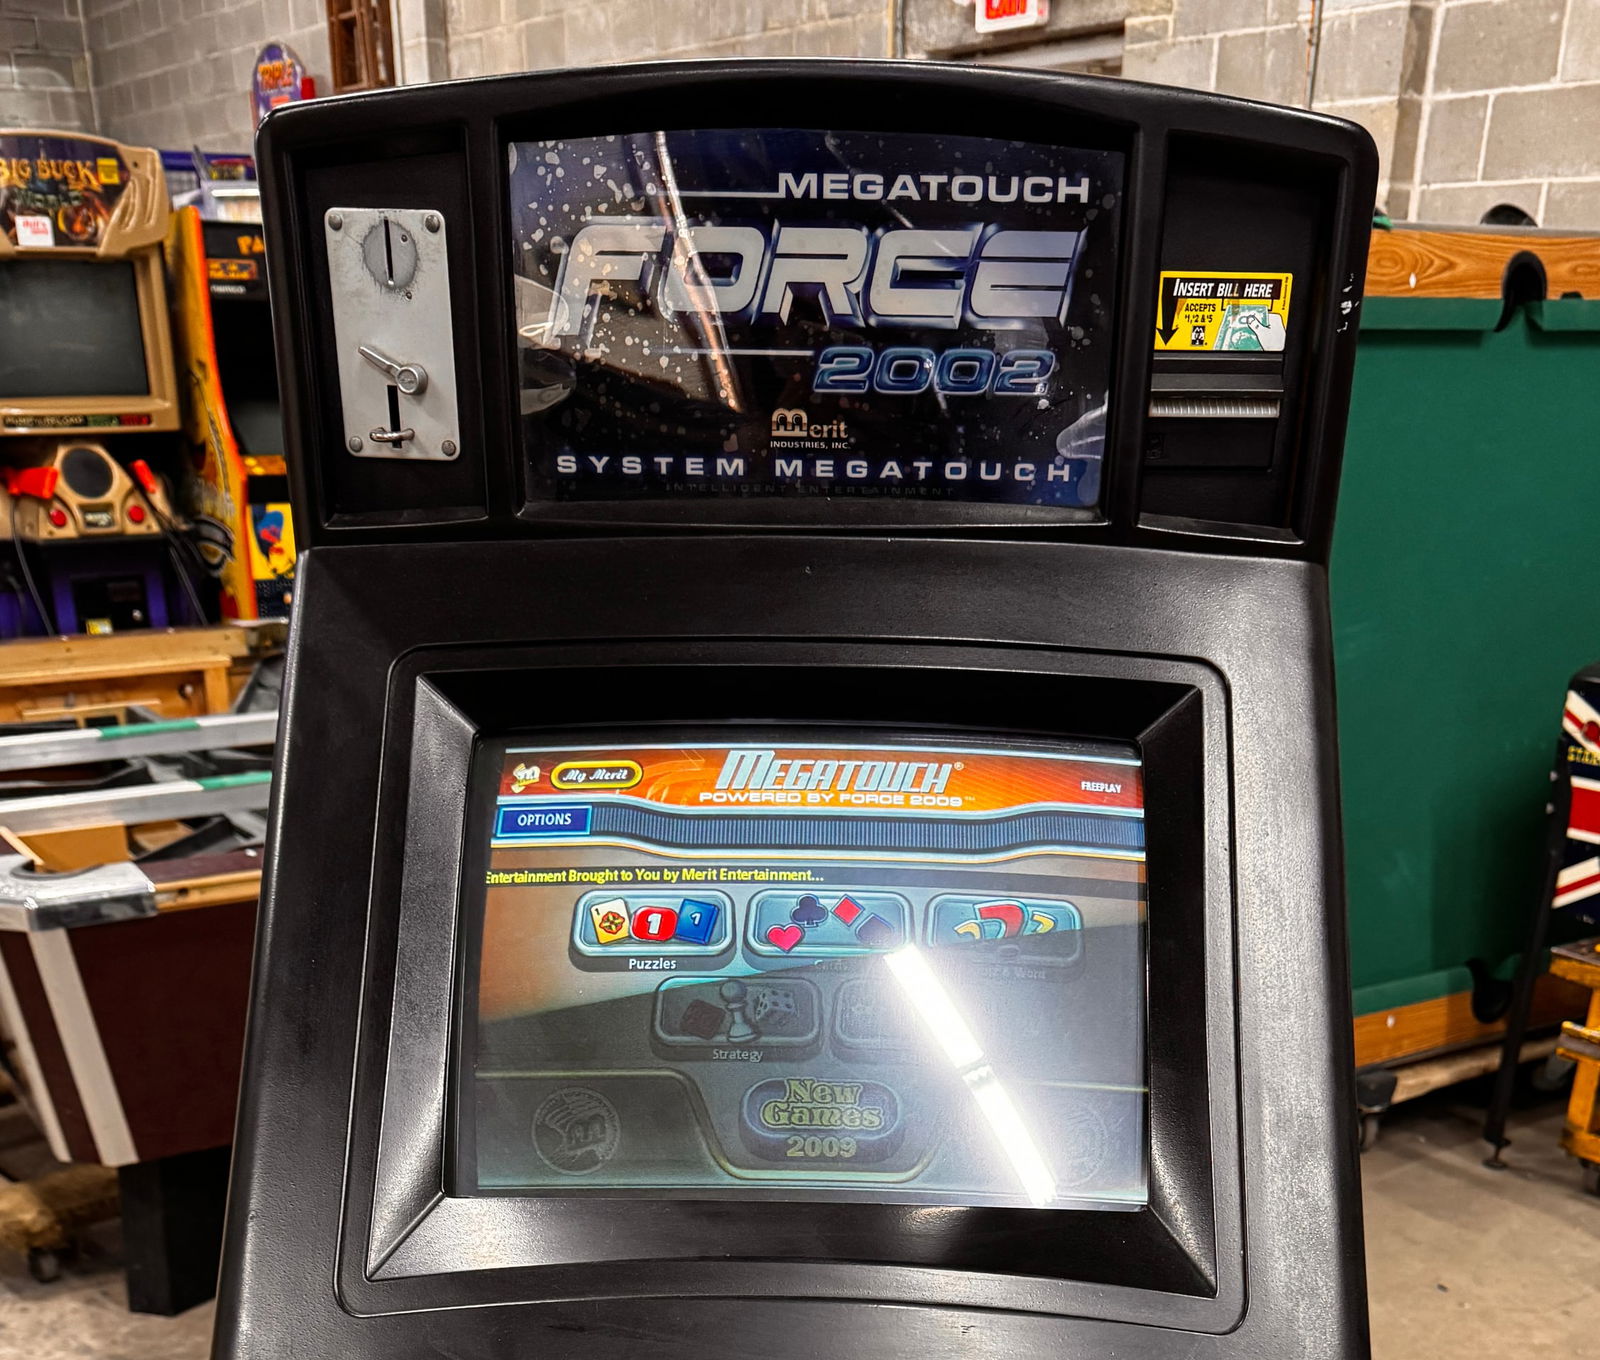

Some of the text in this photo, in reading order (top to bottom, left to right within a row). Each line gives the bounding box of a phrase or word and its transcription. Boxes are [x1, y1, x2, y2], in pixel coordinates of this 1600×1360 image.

[37, 158, 103, 192] BUCK
[778, 171, 1088, 204] MEGATOUCH
[547, 218, 1088, 350] FORCE
[1173, 278, 1214, 297] INSERT
[1217, 283, 1239, 297] BILL
[1243, 283, 1274, 298] HERE
[1184, 303, 1216, 312] ACCEPTS
[814, 346, 1056, 395] 2002
[772, 408, 848, 438] Merit
[557, 455, 1070, 483] SYSTEM MEGATOUCH
[562, 768, 628, 783] My Merit
[1081, 780, 1121, 793] FREEPLAY
[699, 792, 797, 804] POWERED
[800, 793, 834, 804] BY
[839, 794, 907, 806] FORCE
[517, 813, 571, 826] OPTIONS
[568, 870, 618, 884] Brought
[621, 869, 633, 882] to
[635, 869, 661, 882] You
[663, 868, 678, 884] by
[681, 867, 718, 881] Merit
[719, 868, 824, 883] Entertainment...
[628, 957, 677, 970] Puzzles
[712, 1048, 763, 1063] Strategy
[787, 1078, 861, 1104] New
[762, 1101, 882, 1127] Games
[787, 1135, 857, 1158] 2009
